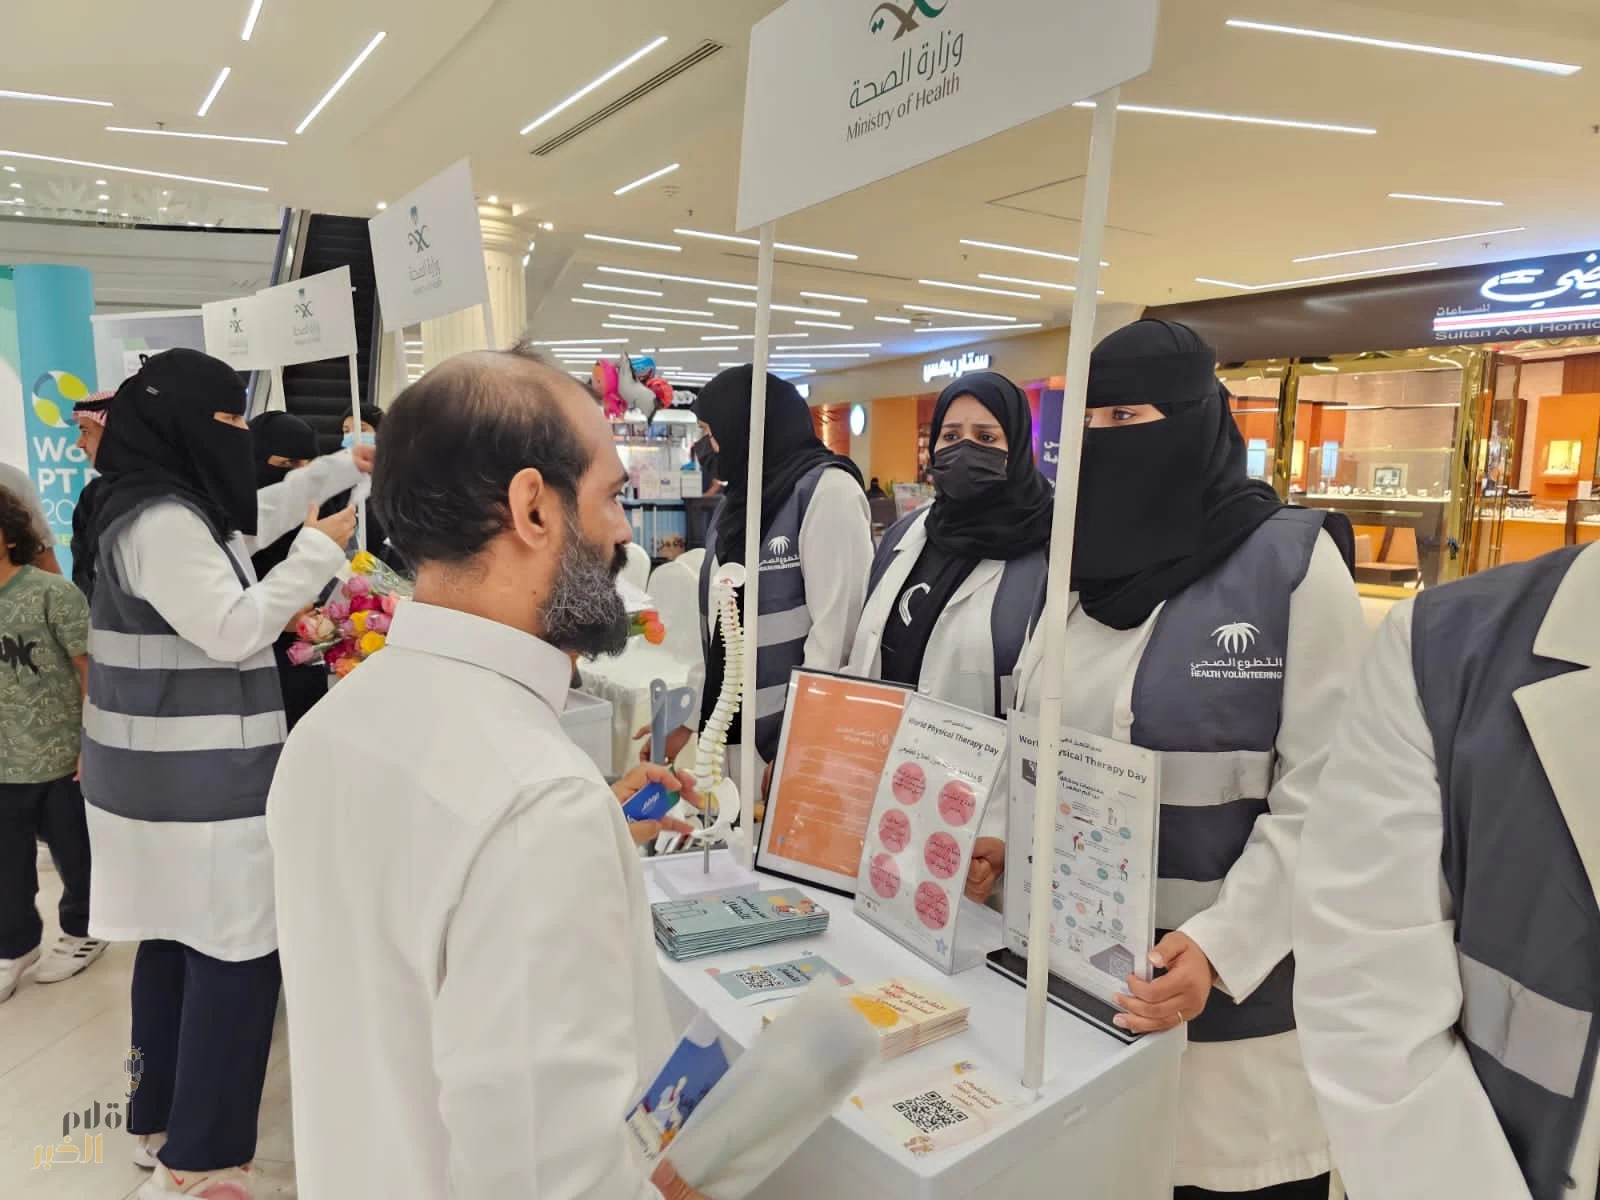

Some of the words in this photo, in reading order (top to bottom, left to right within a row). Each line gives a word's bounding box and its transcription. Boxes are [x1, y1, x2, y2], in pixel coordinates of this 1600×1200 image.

[917, 29, 964, 81] وزارة
[849, 47, 912, 109] الصحة
[846, 106, 895, 141] Ministry
[897, 92, 914, 118] of
[915, 71, 960, 111] Health
[1435, 329, 1491, 341] Sultan
[38, 467, 78, 494] PT
[1190, 657, 1236, 670] الصحي
[1191, 670, 1221, 678] HEALTH
[1222, 670, 1283, 680] VOLUNTEERING
[1237, 657, 1284, 671] التطوع
[927, 723, 955, 740] Physical
[955, 733, 984, 751] Therapy
[984, 743, 1000, 757] Day
[1019, 735, 1040, 748] Worl
[1084, 755, 1125, 777] Therapy
[1127, 768, 1148, 784] Day
